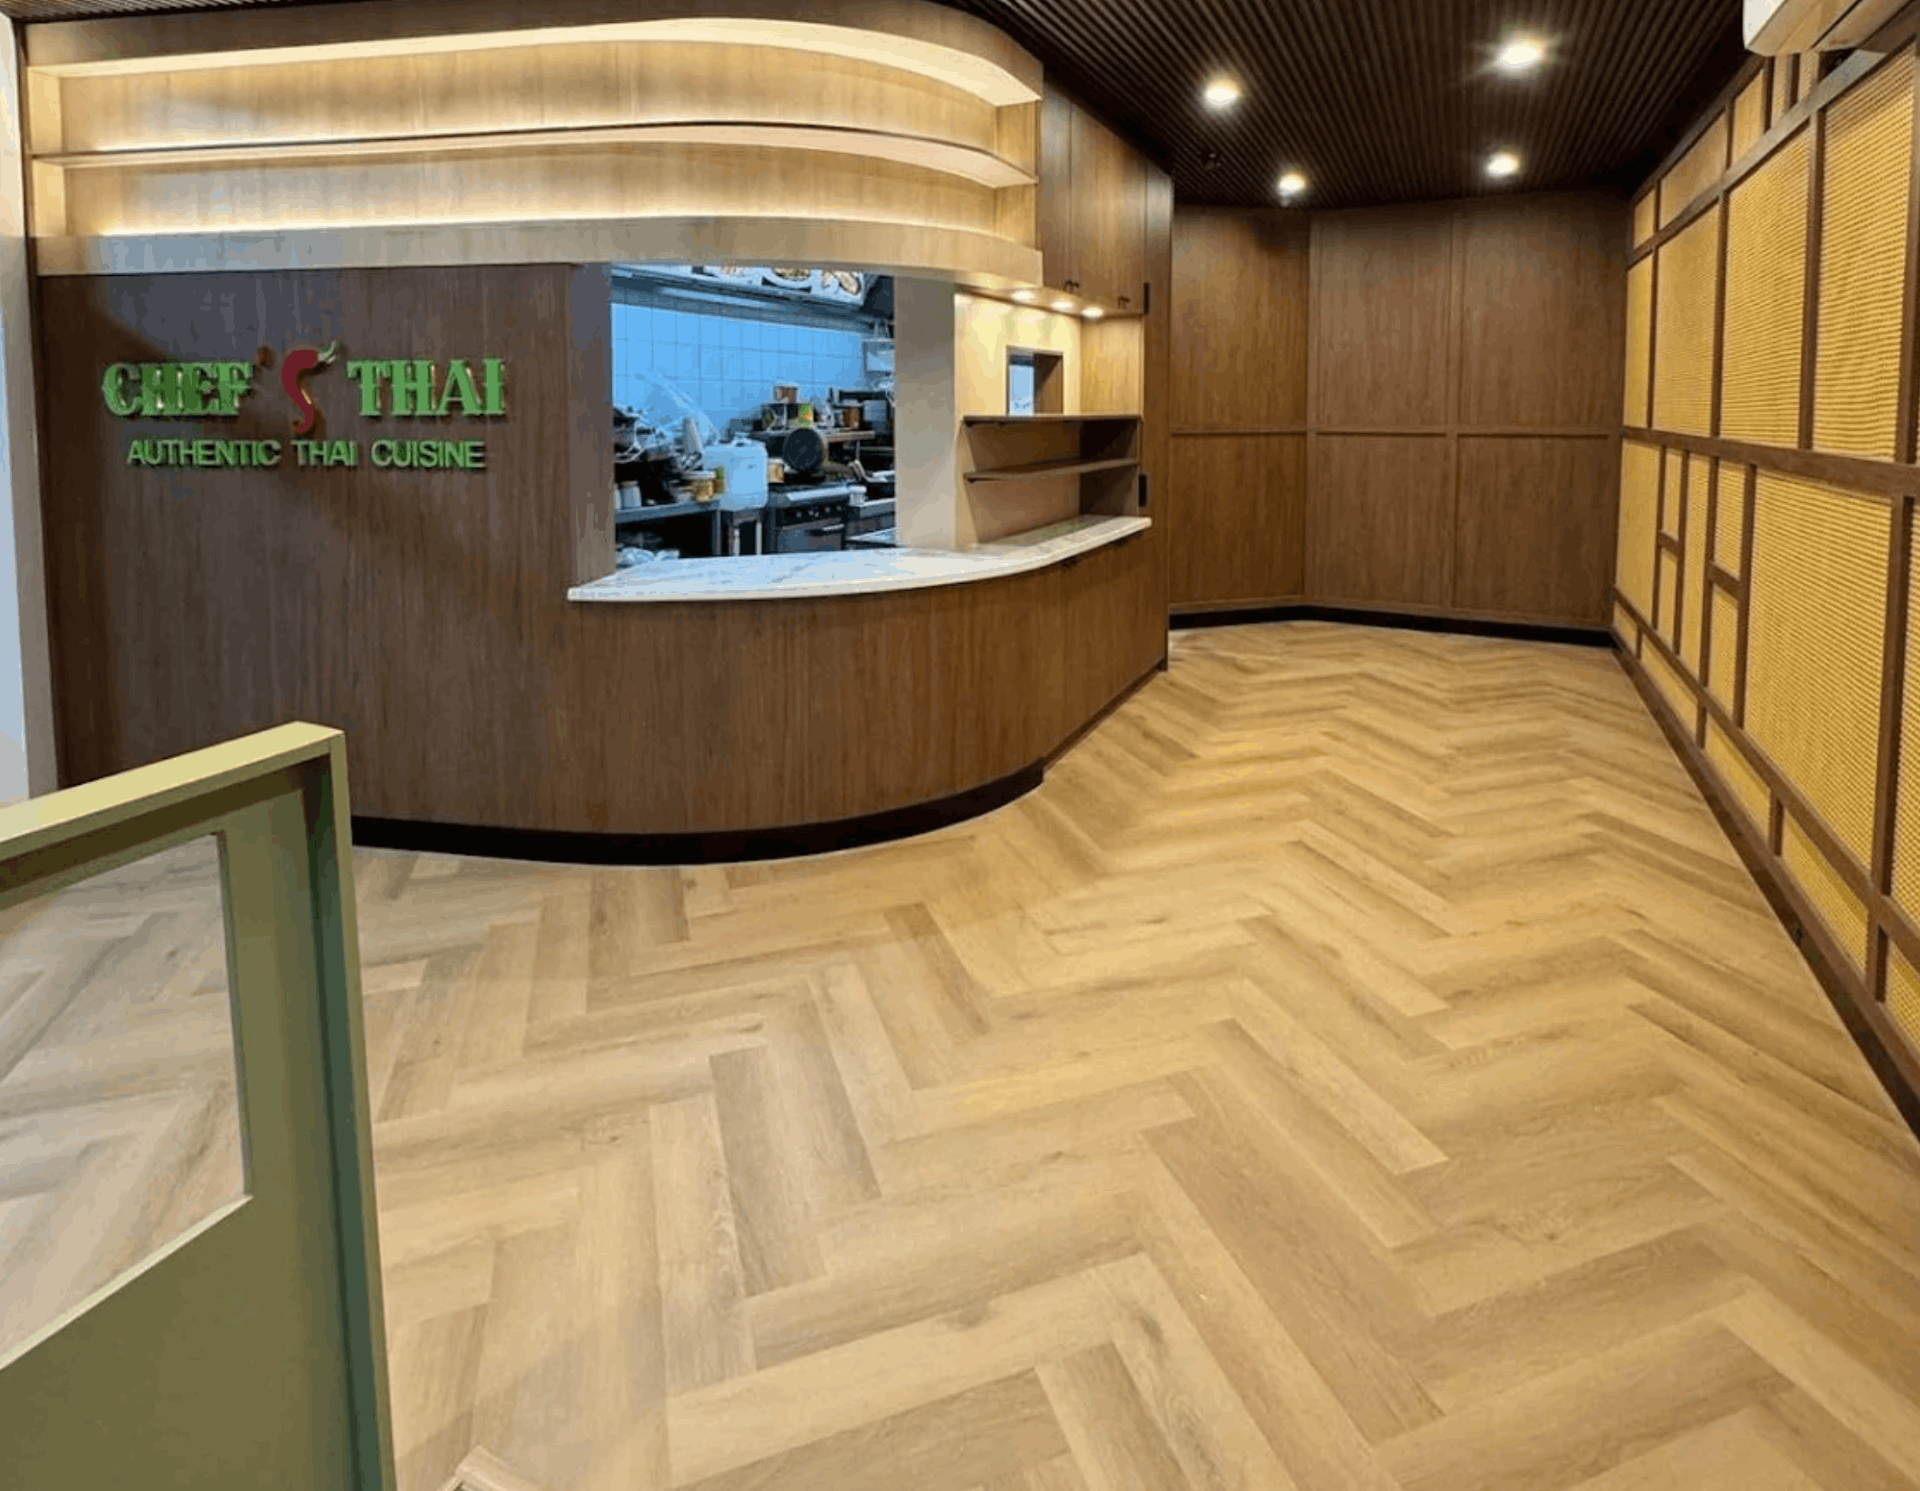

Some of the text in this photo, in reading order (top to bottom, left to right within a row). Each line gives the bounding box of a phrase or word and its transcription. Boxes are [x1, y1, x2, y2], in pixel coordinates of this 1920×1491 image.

[346, 357, 506, 417] THAI
[126, 438, 487, 469] AUTHENTIC THAI CUISINE
